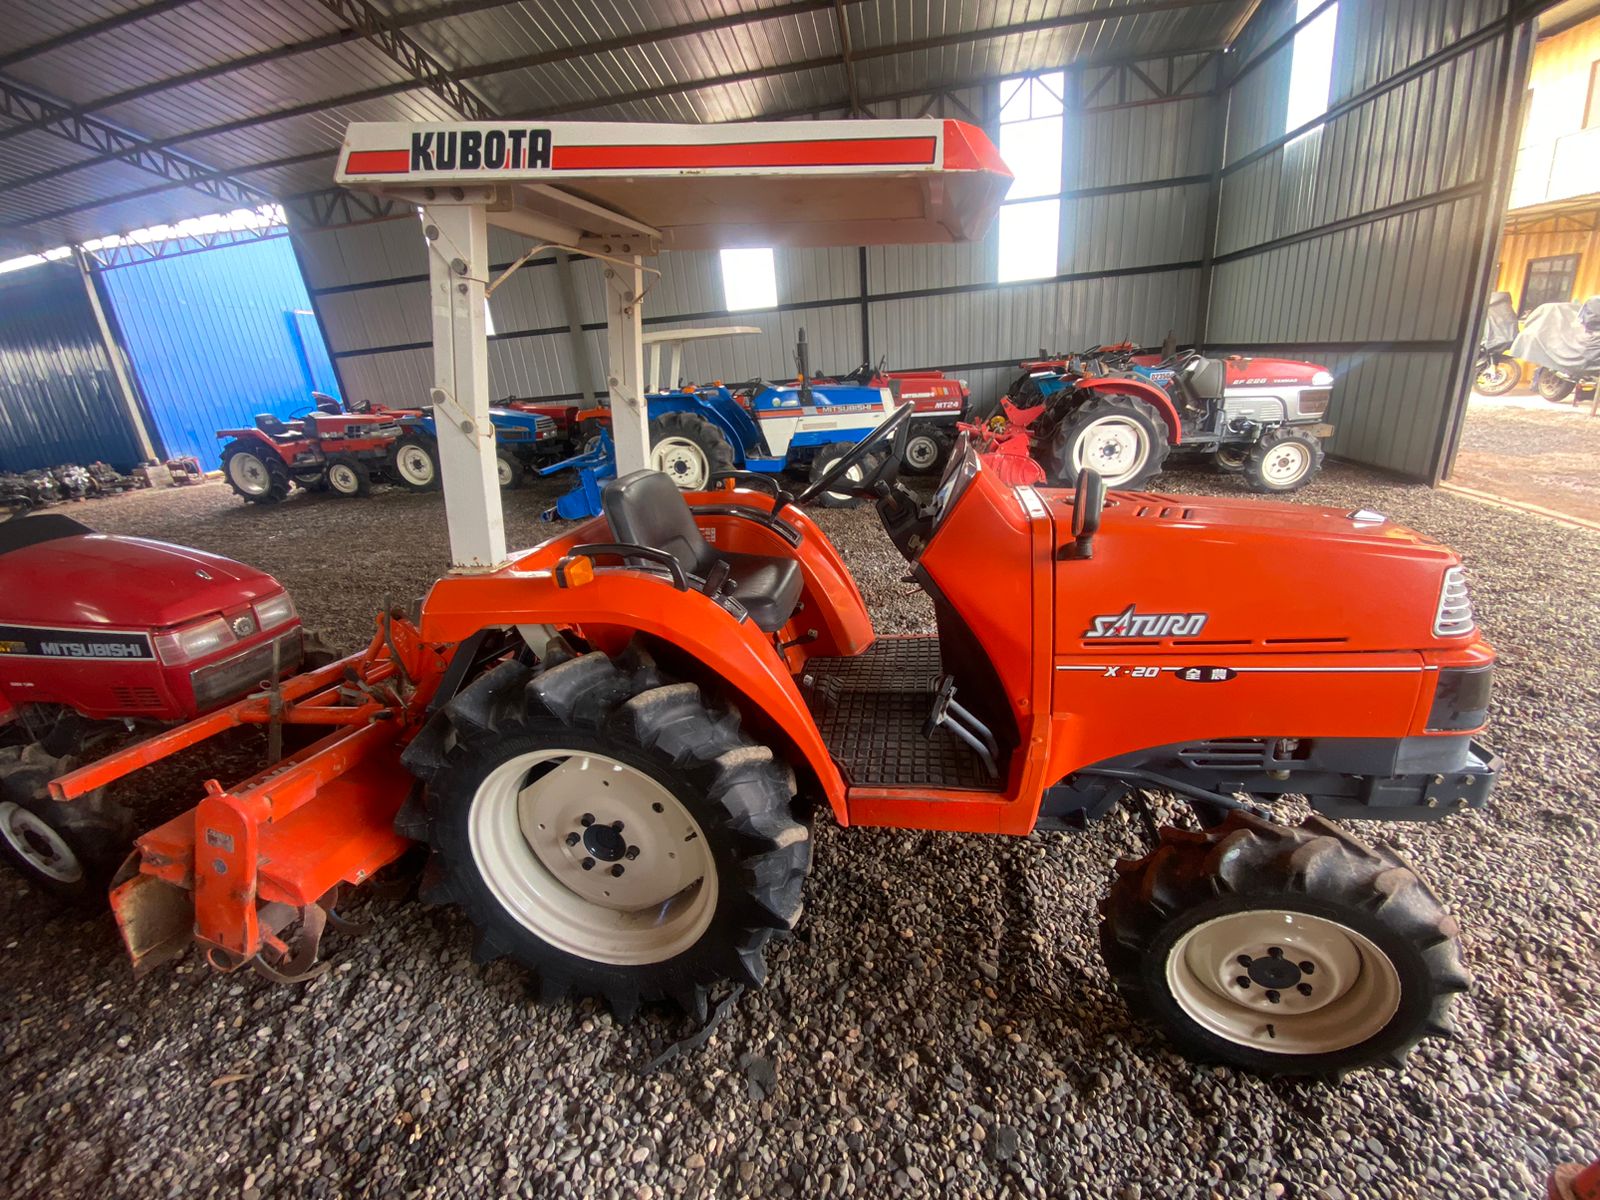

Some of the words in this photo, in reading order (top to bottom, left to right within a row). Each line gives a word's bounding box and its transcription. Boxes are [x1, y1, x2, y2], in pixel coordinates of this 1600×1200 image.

[411, 129, 552, 171] KUBOTA
[822, 404, 872, 413] MITSUBISHI
[934, 401, 959, 409] MT24
[1081, 603, 1208, 638] SATURN
[40, 642, 142, 657] MITSUBISHI
